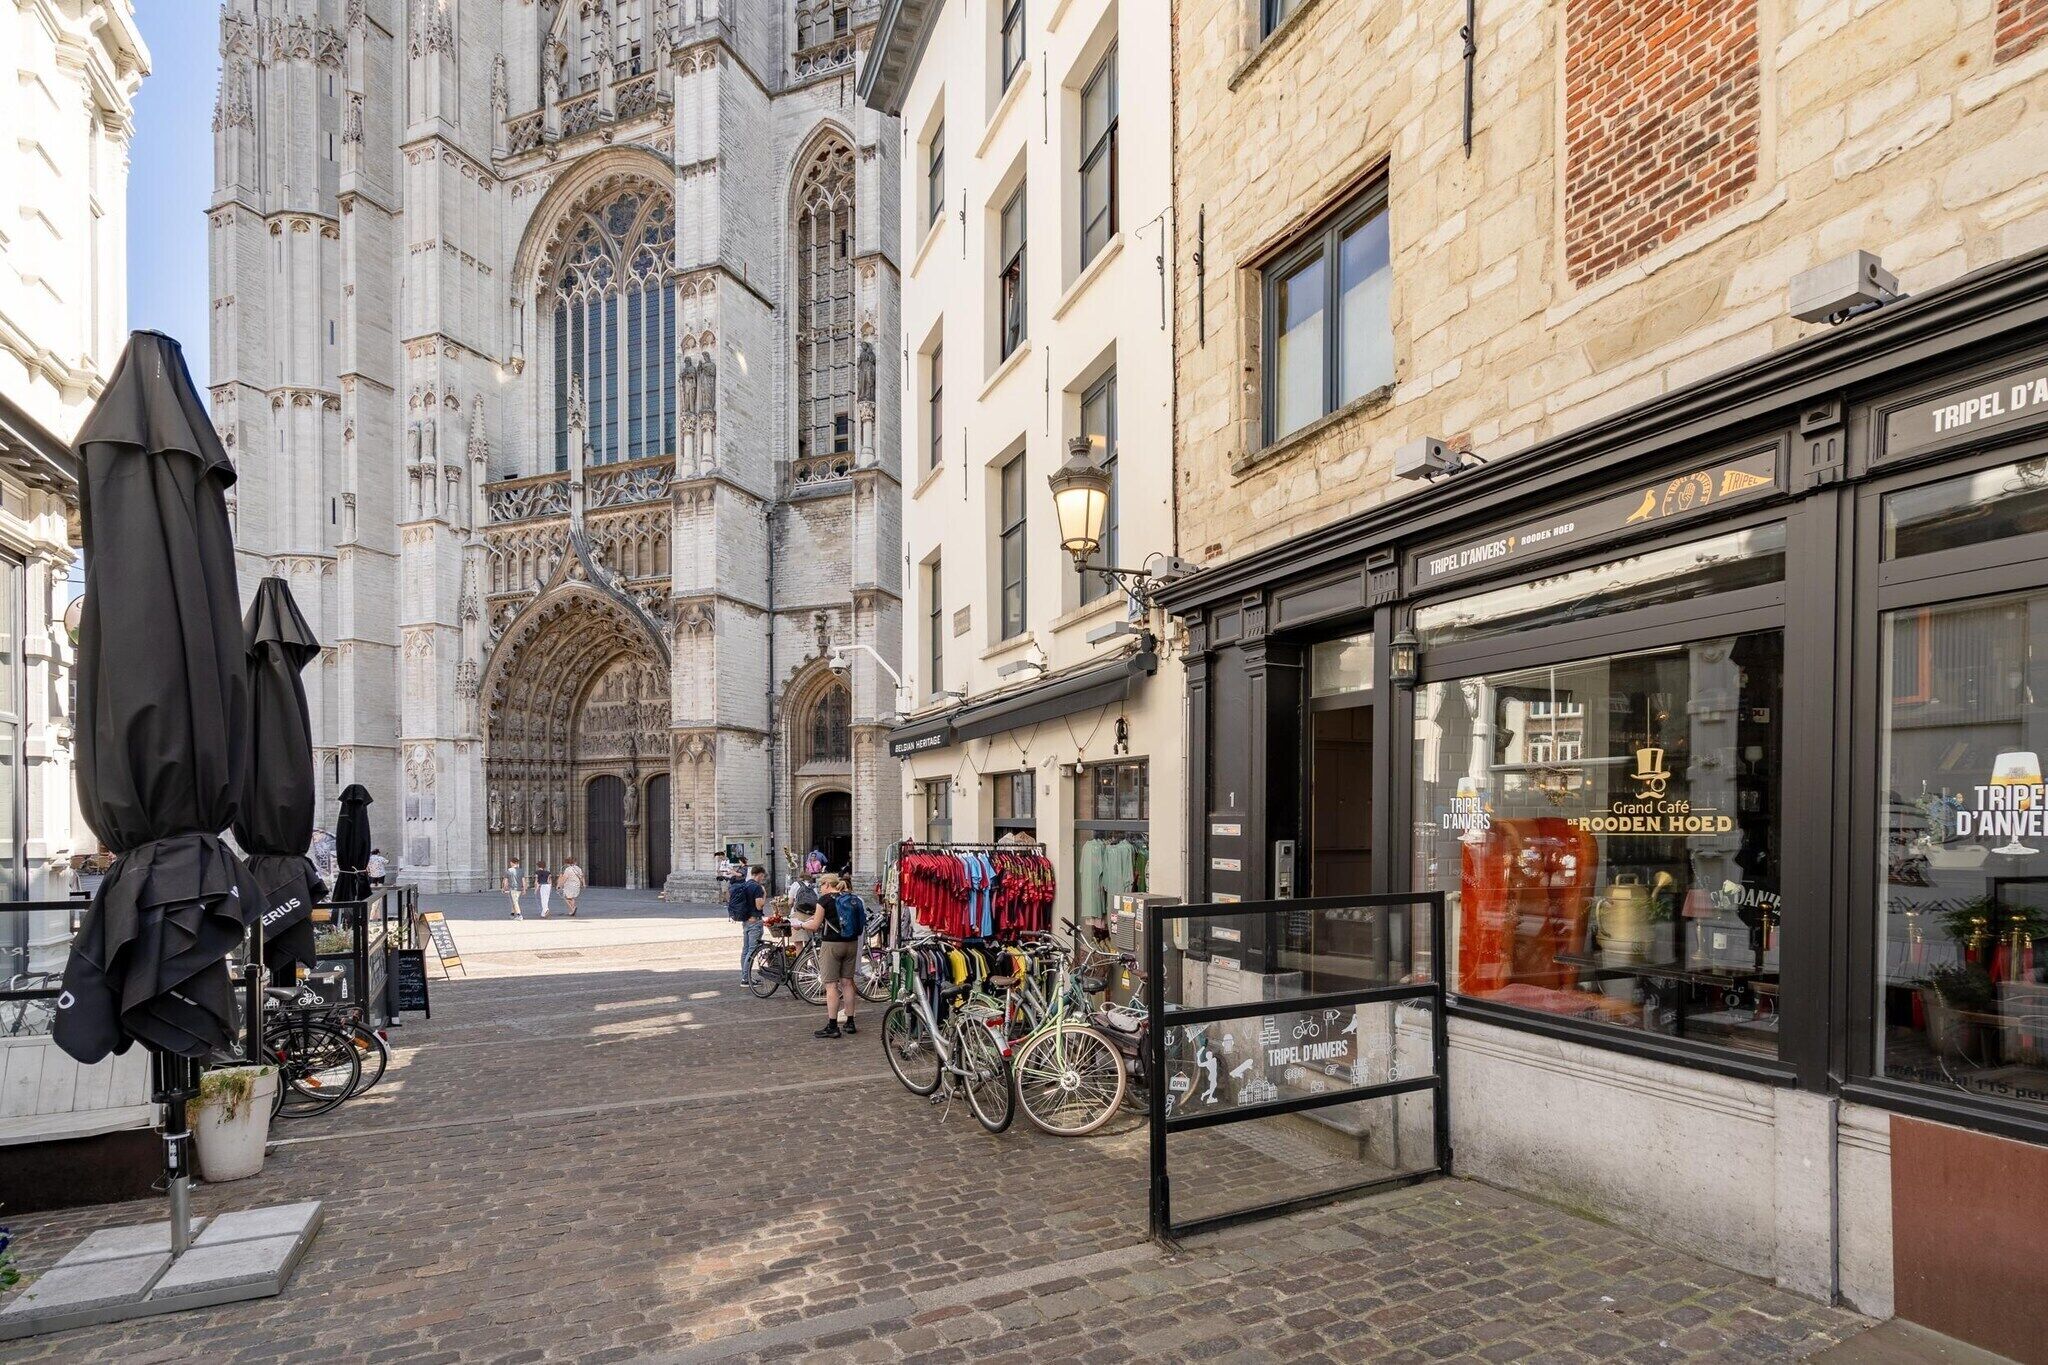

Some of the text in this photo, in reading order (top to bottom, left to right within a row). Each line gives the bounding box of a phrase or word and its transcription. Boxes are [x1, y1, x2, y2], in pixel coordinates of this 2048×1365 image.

[1933, 391, 2005, 433] TRIPEL
[1727, 472, 1758, 491] TRIPEL
[1430, 522, 1575, 576] TRIPEL D'ANVERS ROODEN HOED
[895, 734, 941, 753] BELGIAN HERITAGE
[1229, 792, 1235, 808] 1
[1450, 797, 1483, 813] TRIPEL
[1613, 800, 1690, 814] Grand Café
[1443, 813, 1491, 830] D'ANVERS
[1567, 816, 1732, 832] DE ROODEN HOED
[1268, 1039, 1348, 1067] TRIPEL D'ANVERS
